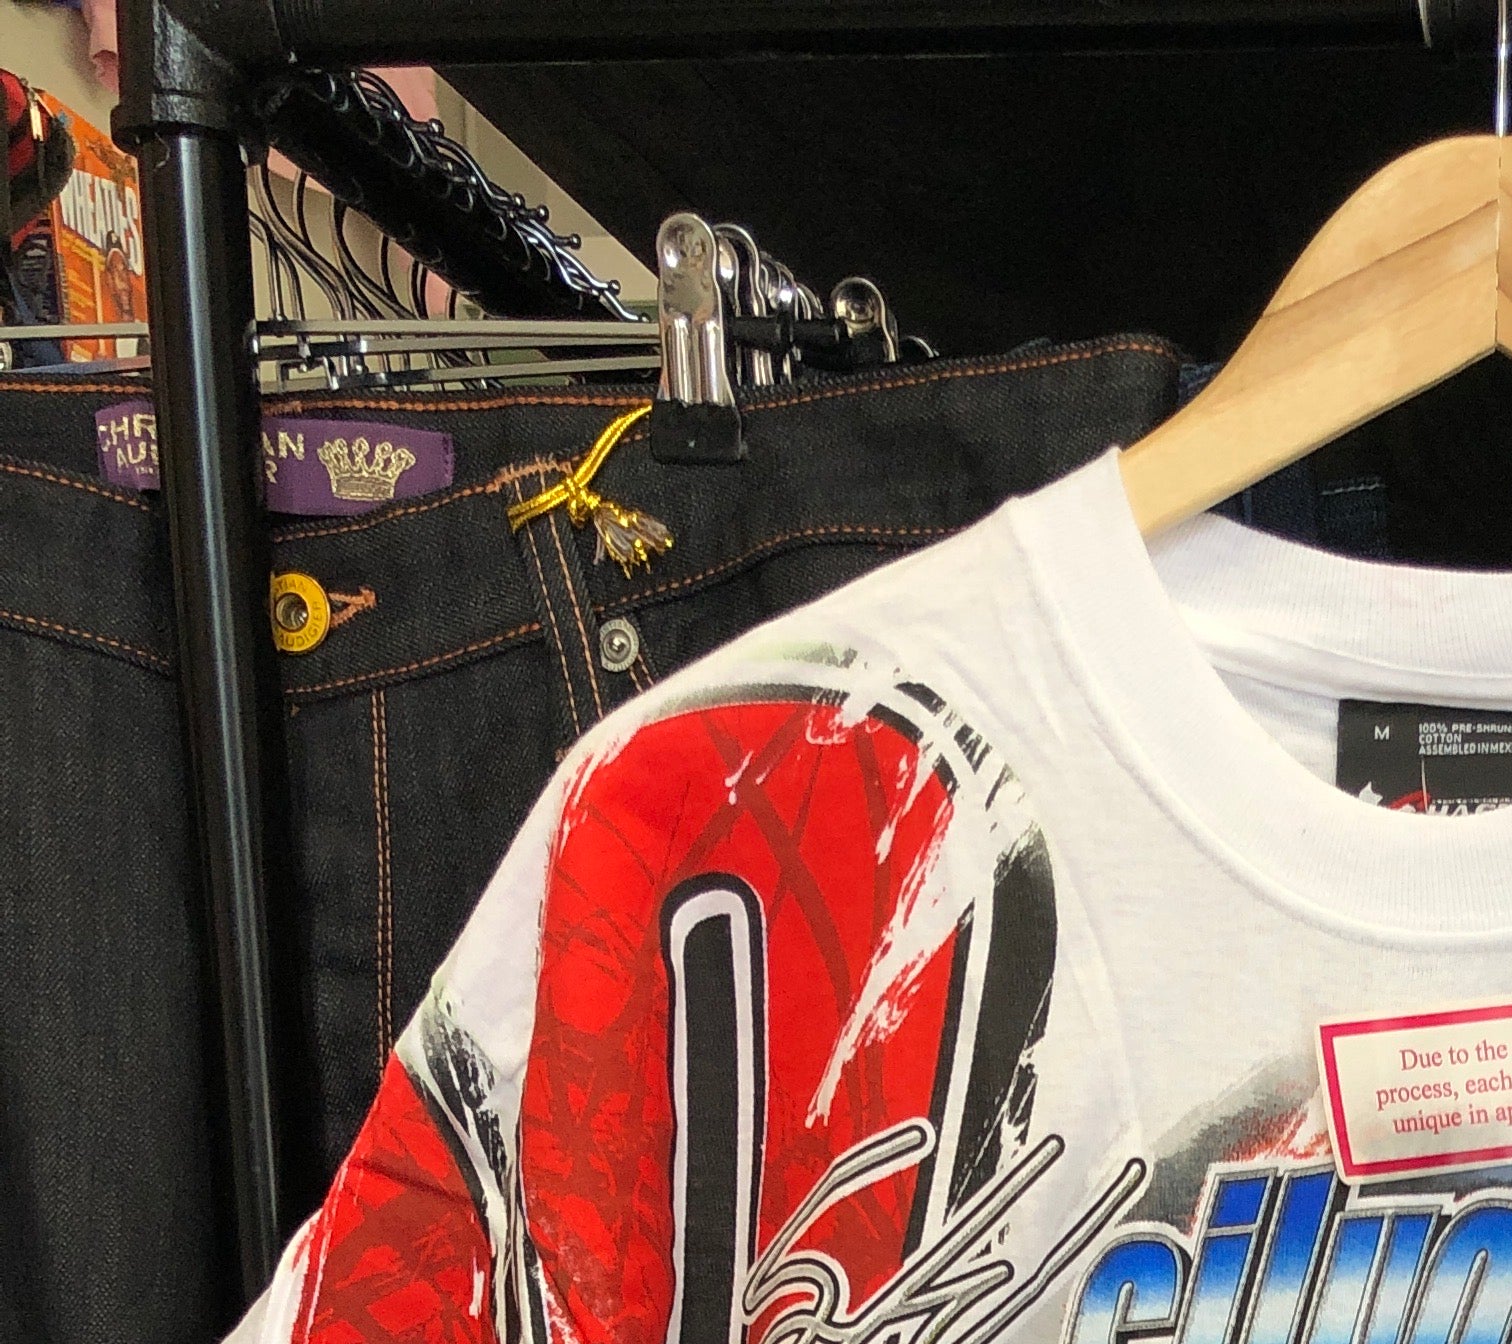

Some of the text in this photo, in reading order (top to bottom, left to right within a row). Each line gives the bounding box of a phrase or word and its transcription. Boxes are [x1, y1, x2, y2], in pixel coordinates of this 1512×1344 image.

[1374, 725, 1390, 740] M
[1418, 723, 1448, 734] 100%
[1418, 733, 1462, 744] COTTON
[1418, 743, 1476, 756] ASSEMBLED
[1477, 743, 1489, 754] IN
[1399, 1048, 1443, 1071] Due
[1447, 1046, 1469, 1065] to
[1475, 1040, 1508, 1062] the
[1376, 1081, 1459, 1111] process,
[1393, 1109, 1463, 1135] unique
[1468, 1104, 1489, 1124] in
